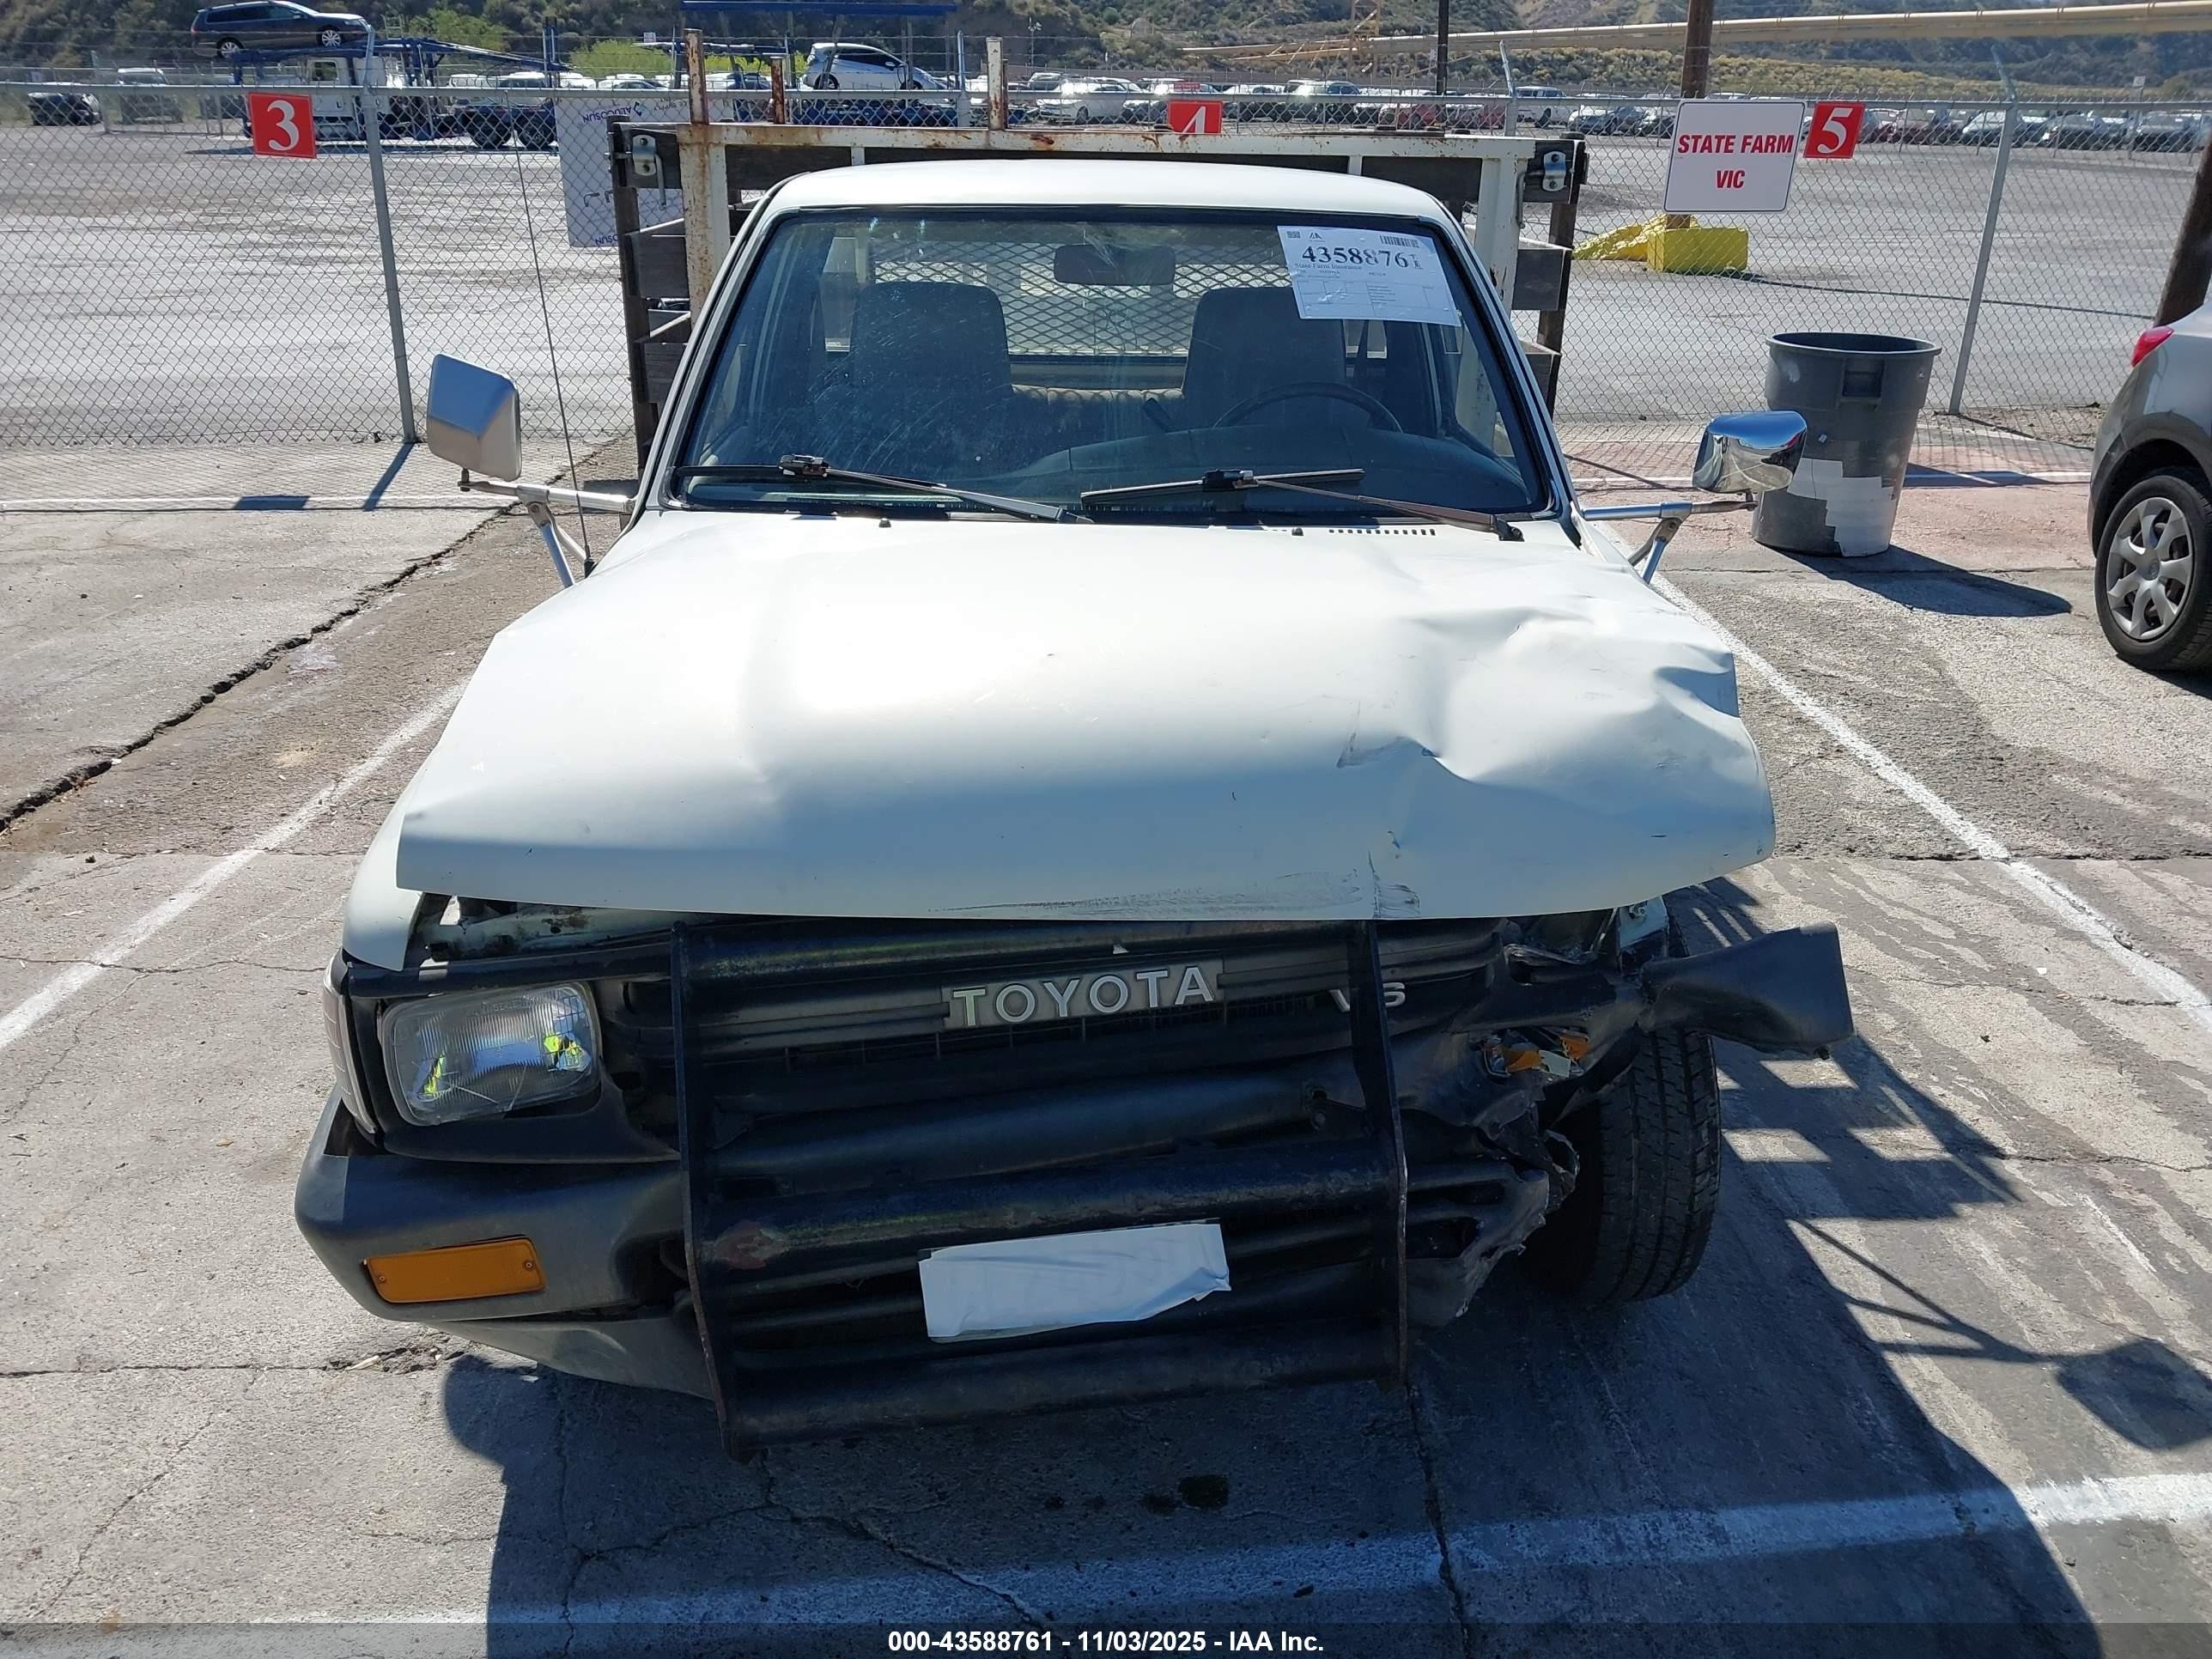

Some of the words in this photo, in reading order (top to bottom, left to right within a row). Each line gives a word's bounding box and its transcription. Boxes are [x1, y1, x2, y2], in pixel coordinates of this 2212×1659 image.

[266, 99, 300, 151] 3
[1816, 107, 1853, 154] 5
[1678, 134, 1736, 154] STATE
[1741, 134, 1795, 154] FARM
[1716, 169, 1746, 189] VIC
[1302, 246, 1424, 270] 43588761
[952, 965, 1215, 1027] TOYOTA
